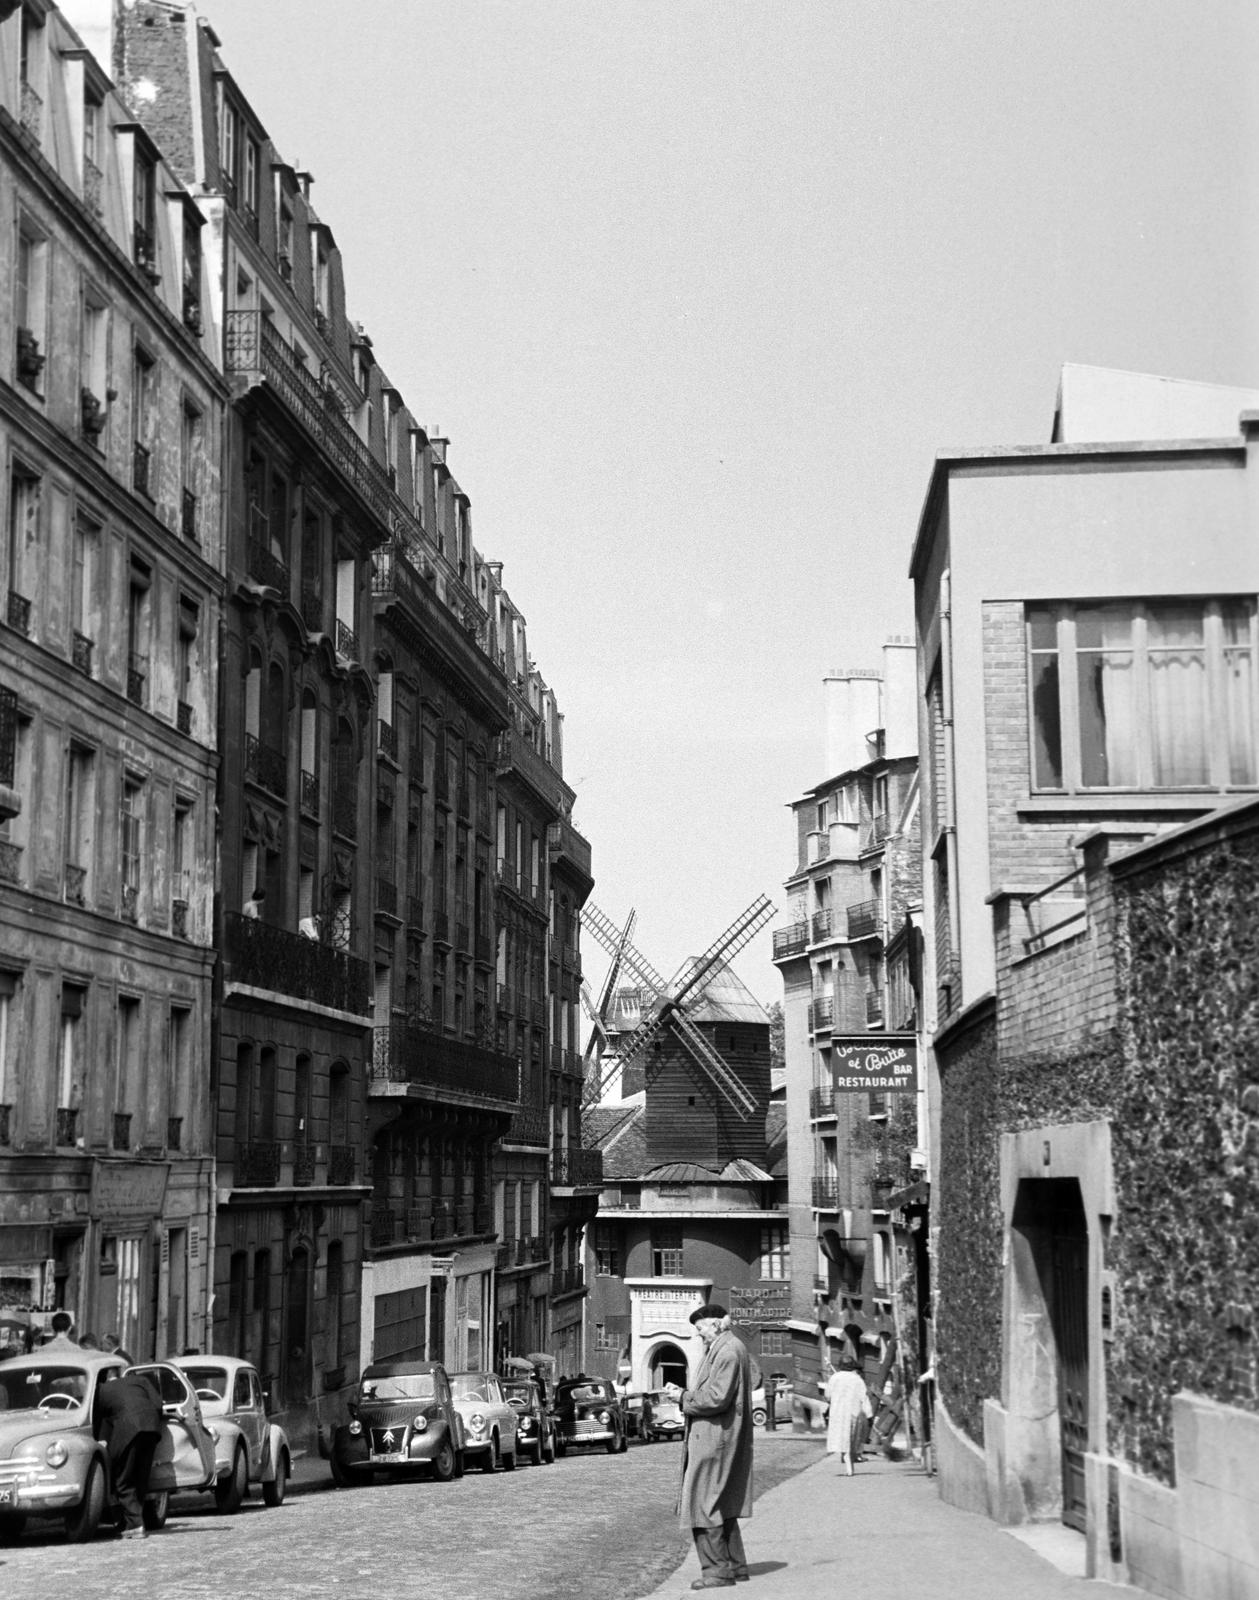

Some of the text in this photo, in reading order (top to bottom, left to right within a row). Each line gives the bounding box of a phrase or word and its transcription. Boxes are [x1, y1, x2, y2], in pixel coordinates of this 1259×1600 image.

[848, 1057, 861, 1070] et
[865, 1048, 907, 1071] Butte
[893, 1065, 913, 1075] BAR
[838, 1077, 908, 1087] RESTAURANT
